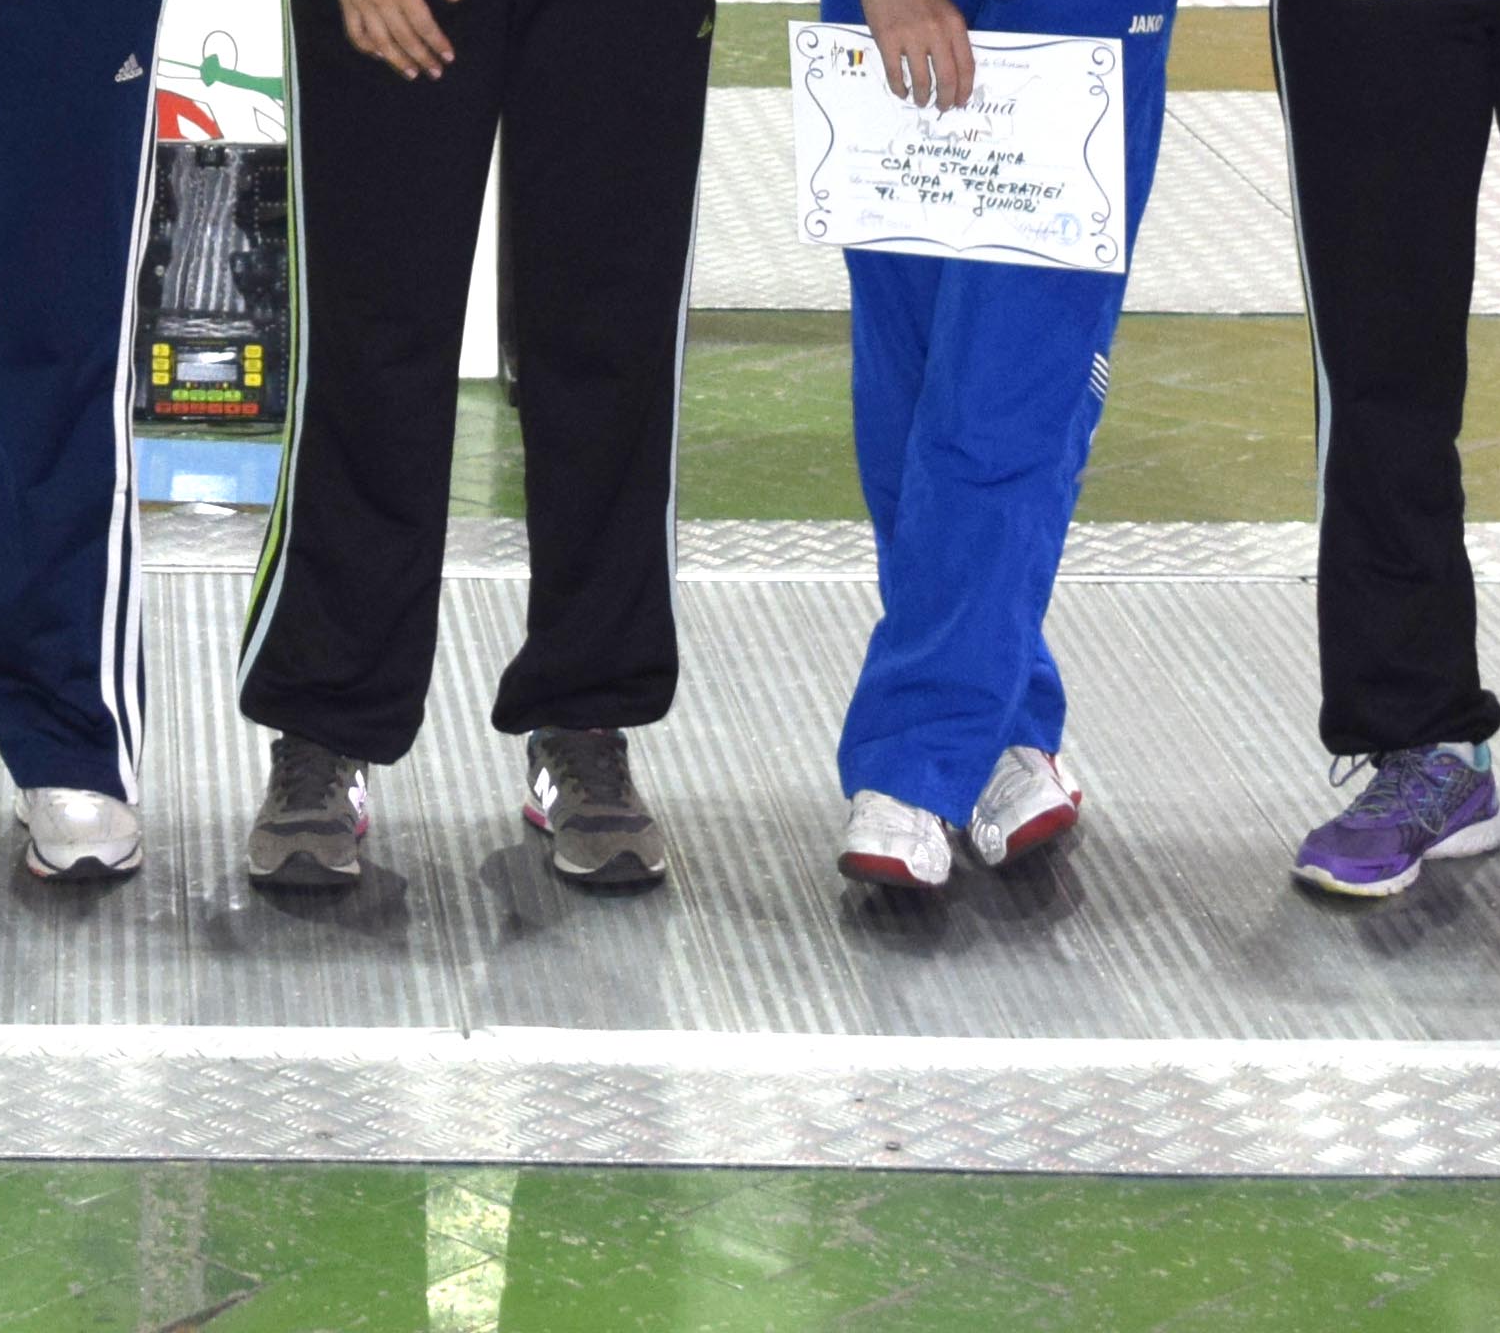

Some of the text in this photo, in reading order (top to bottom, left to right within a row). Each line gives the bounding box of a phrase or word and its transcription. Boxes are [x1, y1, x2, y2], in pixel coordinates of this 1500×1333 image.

[1128, 14, 1164, 33] JAKO
[987, 149, 1025, 166] ANCA
[880, 158, 1000, 178] CSA STEAUA
[900, 173, 942, 188] CUPA
